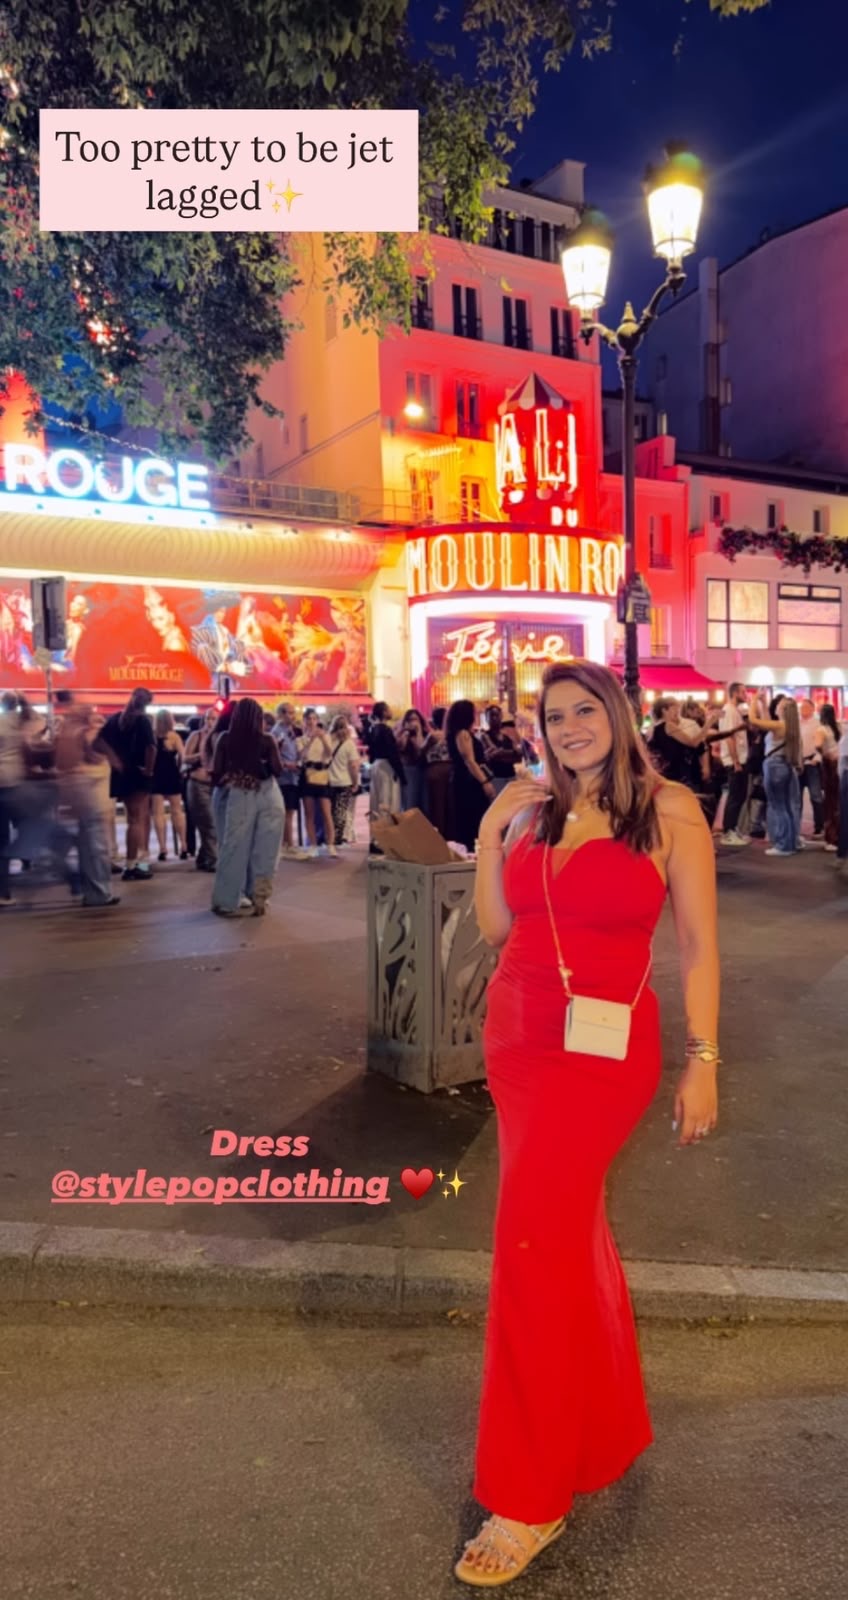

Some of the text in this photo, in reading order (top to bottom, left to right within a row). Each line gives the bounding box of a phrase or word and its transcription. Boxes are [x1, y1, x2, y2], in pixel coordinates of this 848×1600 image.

[4, 442, 211, 510] ROUGE
[551, 506, 578, 527] DU
[405, 532, 626, 597] MOULIN RO
